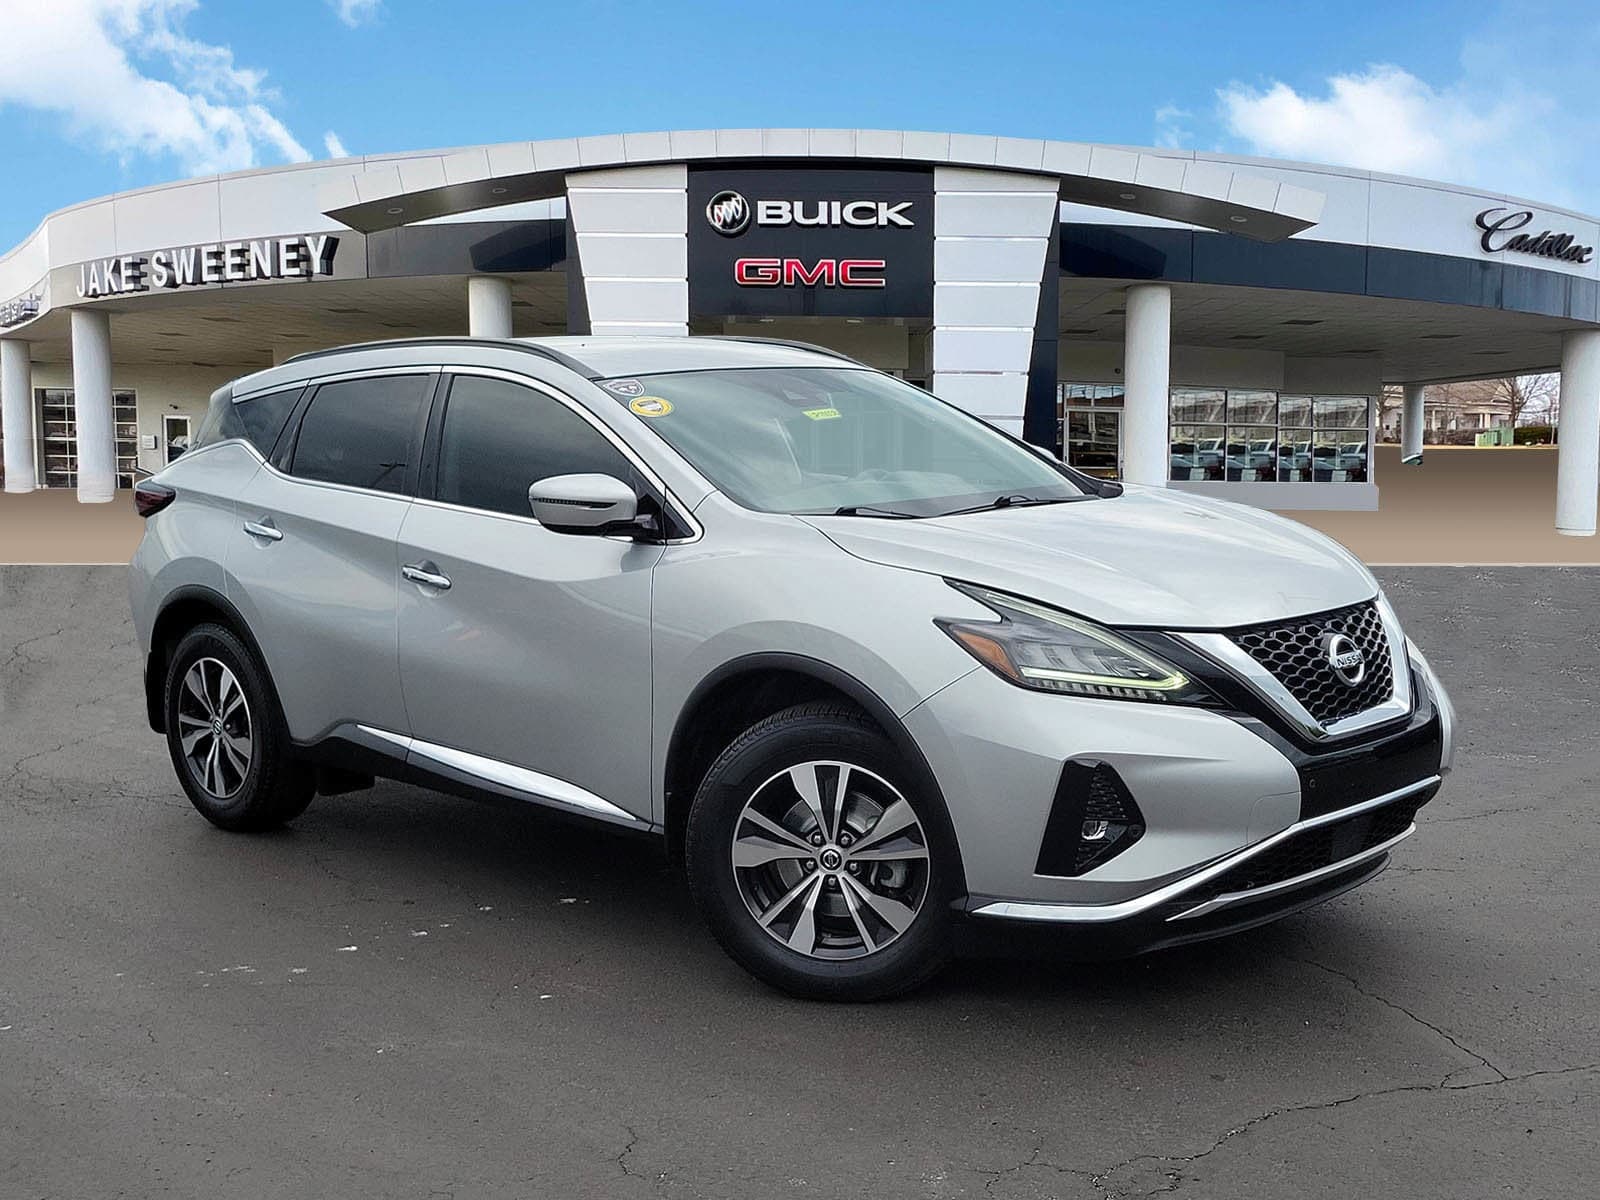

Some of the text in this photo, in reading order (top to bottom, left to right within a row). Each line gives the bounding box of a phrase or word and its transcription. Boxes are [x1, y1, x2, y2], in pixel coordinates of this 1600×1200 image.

[757, 200, 915, 226] BUICK
[76, 234, 335, 298] JAKE SWEENEY
[734, 257, 886, 287] GMC
